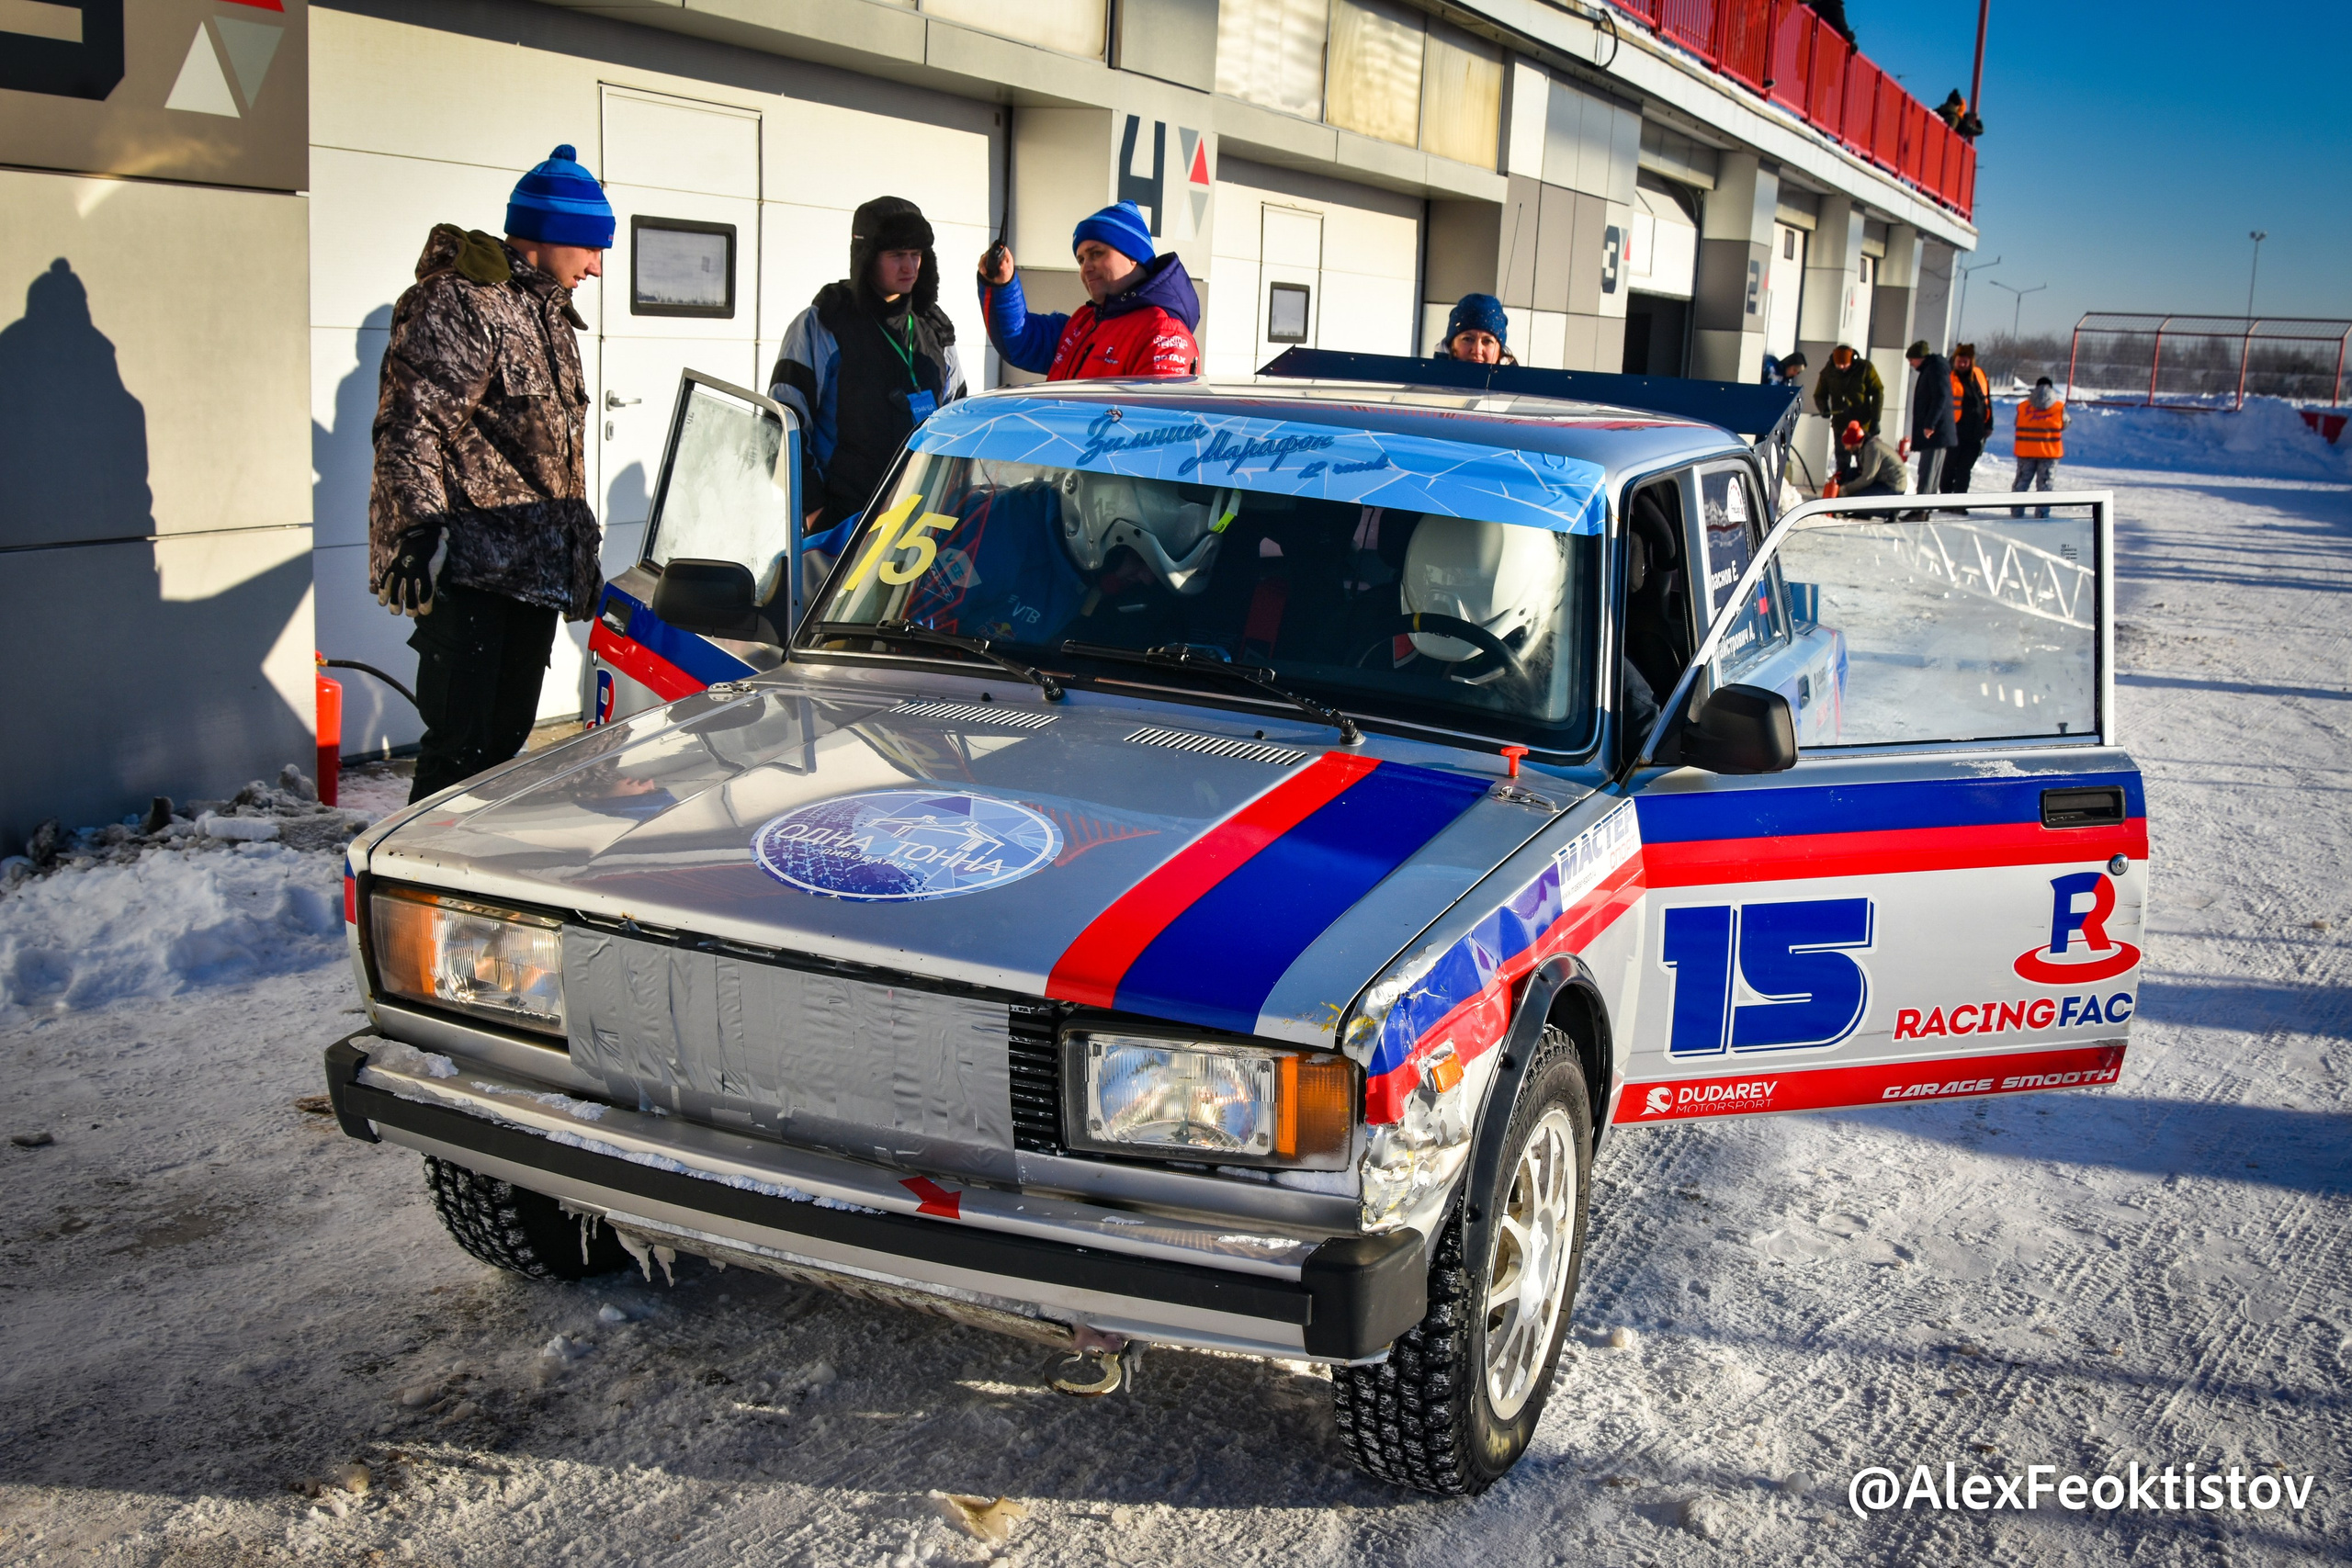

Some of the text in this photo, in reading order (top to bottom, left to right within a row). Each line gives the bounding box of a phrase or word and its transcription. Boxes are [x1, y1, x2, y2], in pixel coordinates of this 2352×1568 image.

[1118, 114, 1166, 238] 4
[1602, 224, 1620, 295] 3
[1746, 258, 1759, 314] 2
[1177, 429, 1334, 476] Марафон
[1297, 460, 1329, 479] 12
[843, 494, 959, 586] 15
[1012, 601, 1041, 624] VTB
[776, 823, 1005, 876] ОДНА ТОННА
[821, 847, 918, 871] ПИВОВАРНЯ
[1558, 799, 1635, 886] МАСТЕР
[1610, 834, 1636, 870] СПОРТ
[1663, 897, 1875, 1058] 15
[1675, 1098, 1774, 1114] MOTORSPORT
[1678, 1080, 1779, 1104] DUDAREV
[1882, 1066, 2118, 1100] GARAGE SMOOTH
